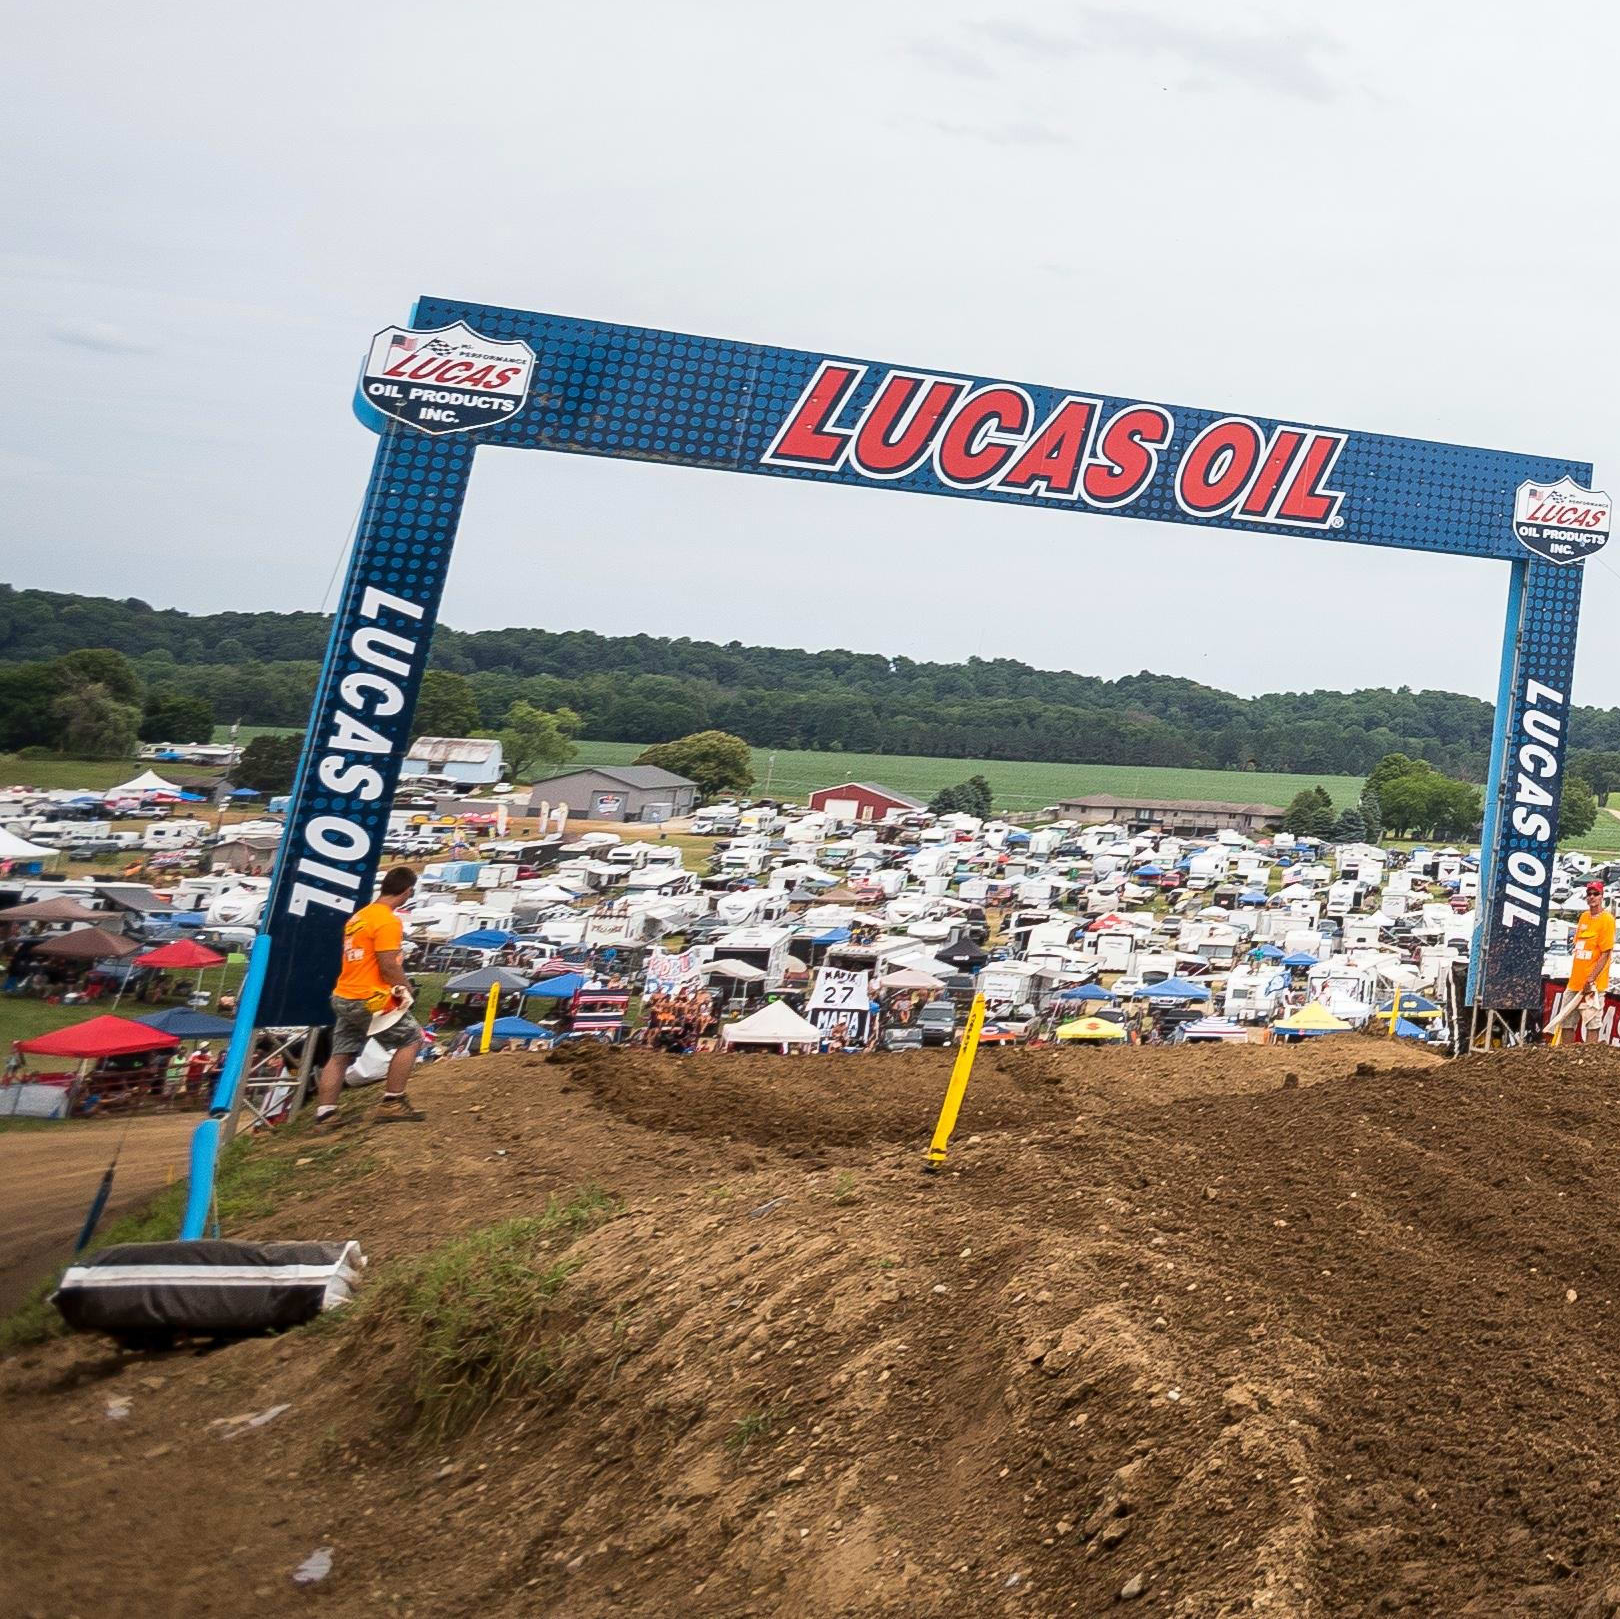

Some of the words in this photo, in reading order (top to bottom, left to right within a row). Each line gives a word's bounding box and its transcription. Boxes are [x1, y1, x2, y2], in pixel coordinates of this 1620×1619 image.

[383, 354, 522, 389] LUCAS
[459, 351, 528, 365] PERFORMANCE
[368, 383, 403, 398] OIL
[409, 387, 515, 412] PRODUCTS
[418, 407, 460, 423] INC.
[761, 359, 1174, 508] LUCAS
[1176, 416, 1349, 529] OIL
[1526, 503, 1606, 527] LUCAS
[1518, 525, 1540, 538] OIL
[1542, 528, 1605, 545] PRODUCTS
[1549, 543, 1575, 555] INC.
[318, 585, 425, 801] LUCAS
[1511, 678, 1564, 842] LUCAS
[287, 815, 371, 917] OIL
[1501, 851, 1546, 928] OIL
[823, 986, 854, 1004] 27
